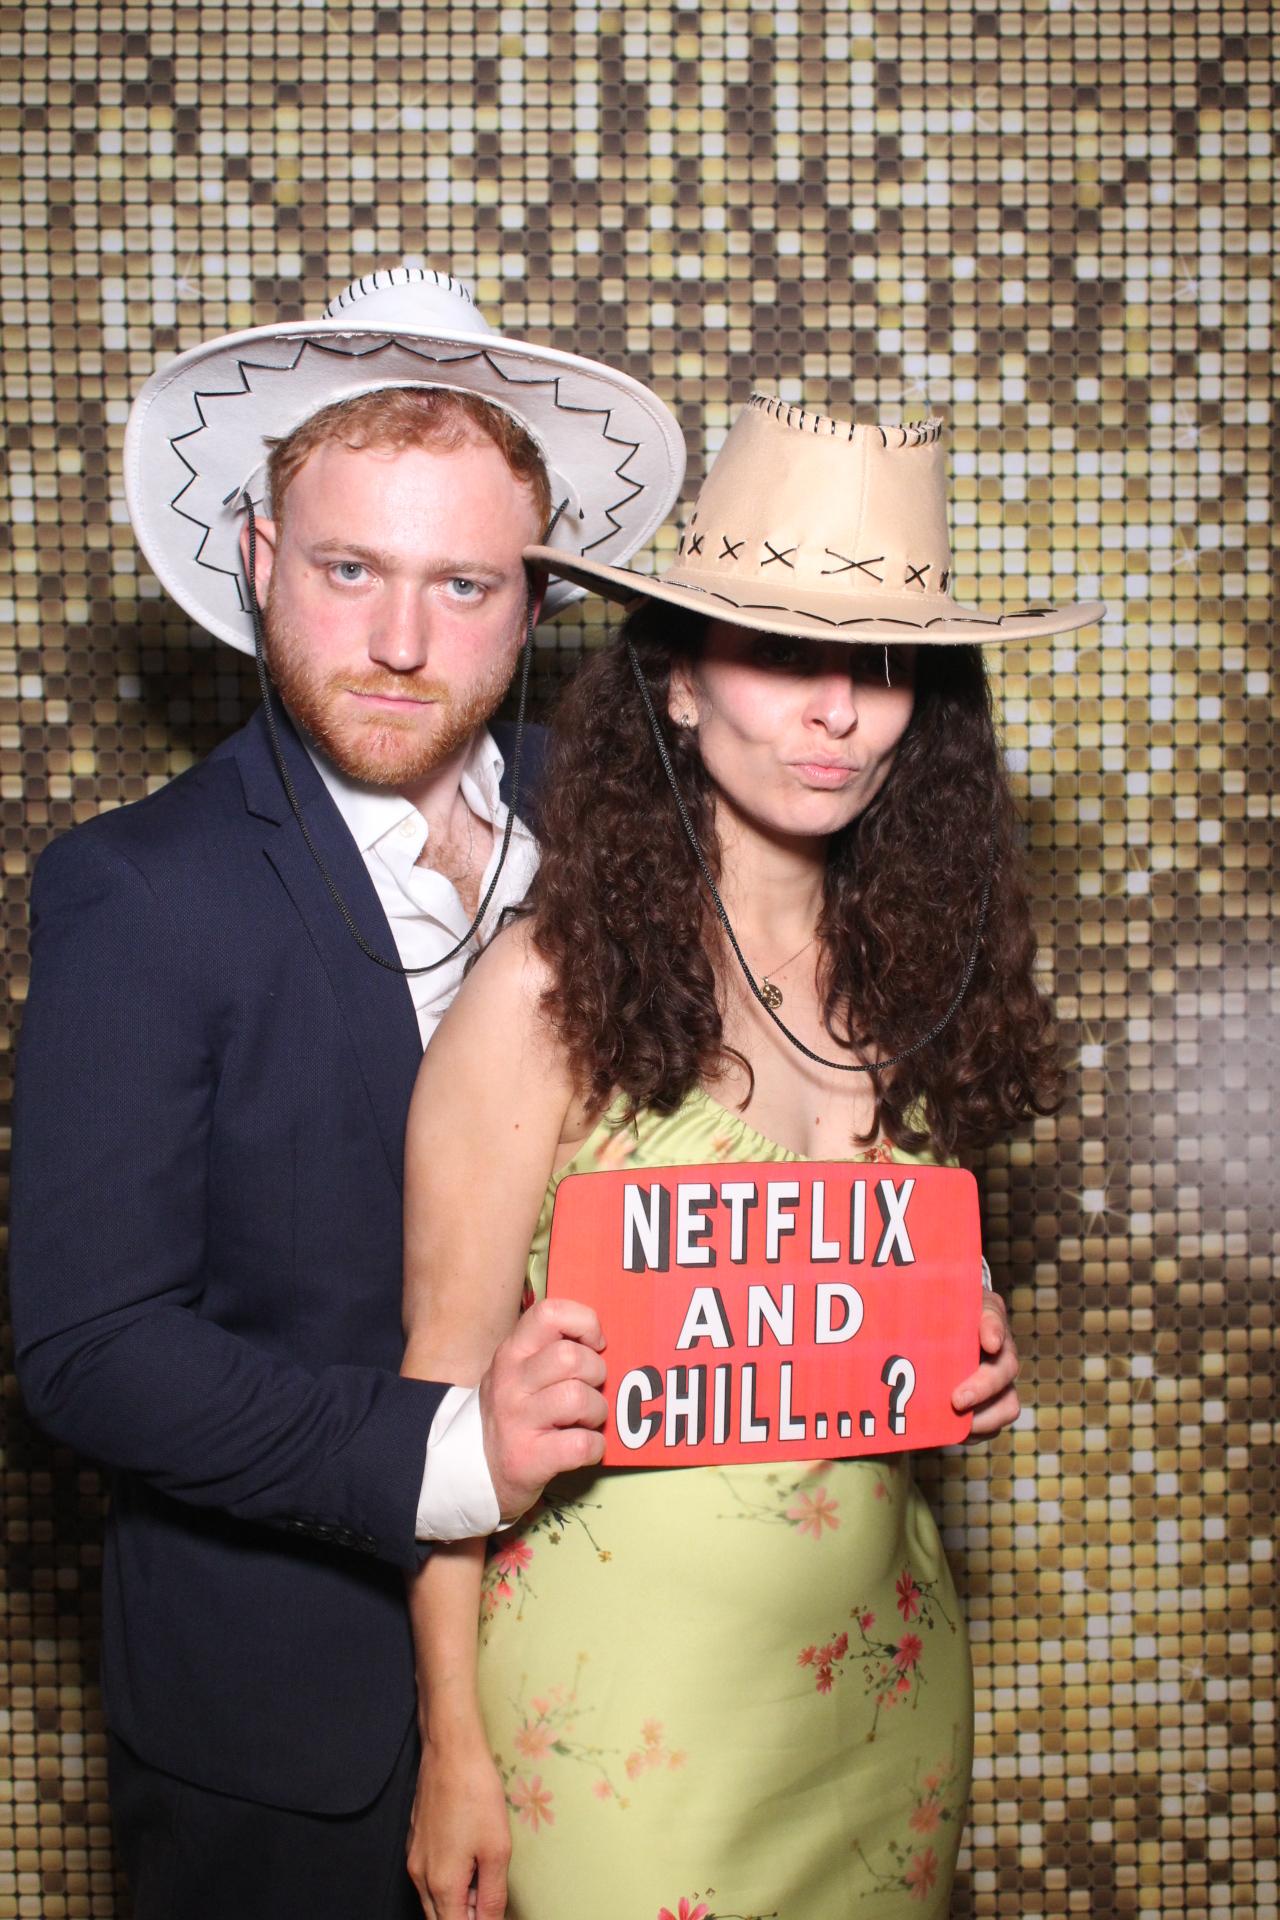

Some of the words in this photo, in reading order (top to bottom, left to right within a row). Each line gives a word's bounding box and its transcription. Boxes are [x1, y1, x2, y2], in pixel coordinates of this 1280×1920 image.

[622, 1178, 916, 1272] NETFLIX
[675, 1282, 864, 1350] AND
[615, 1355, 915, 1450] CHILL...?
